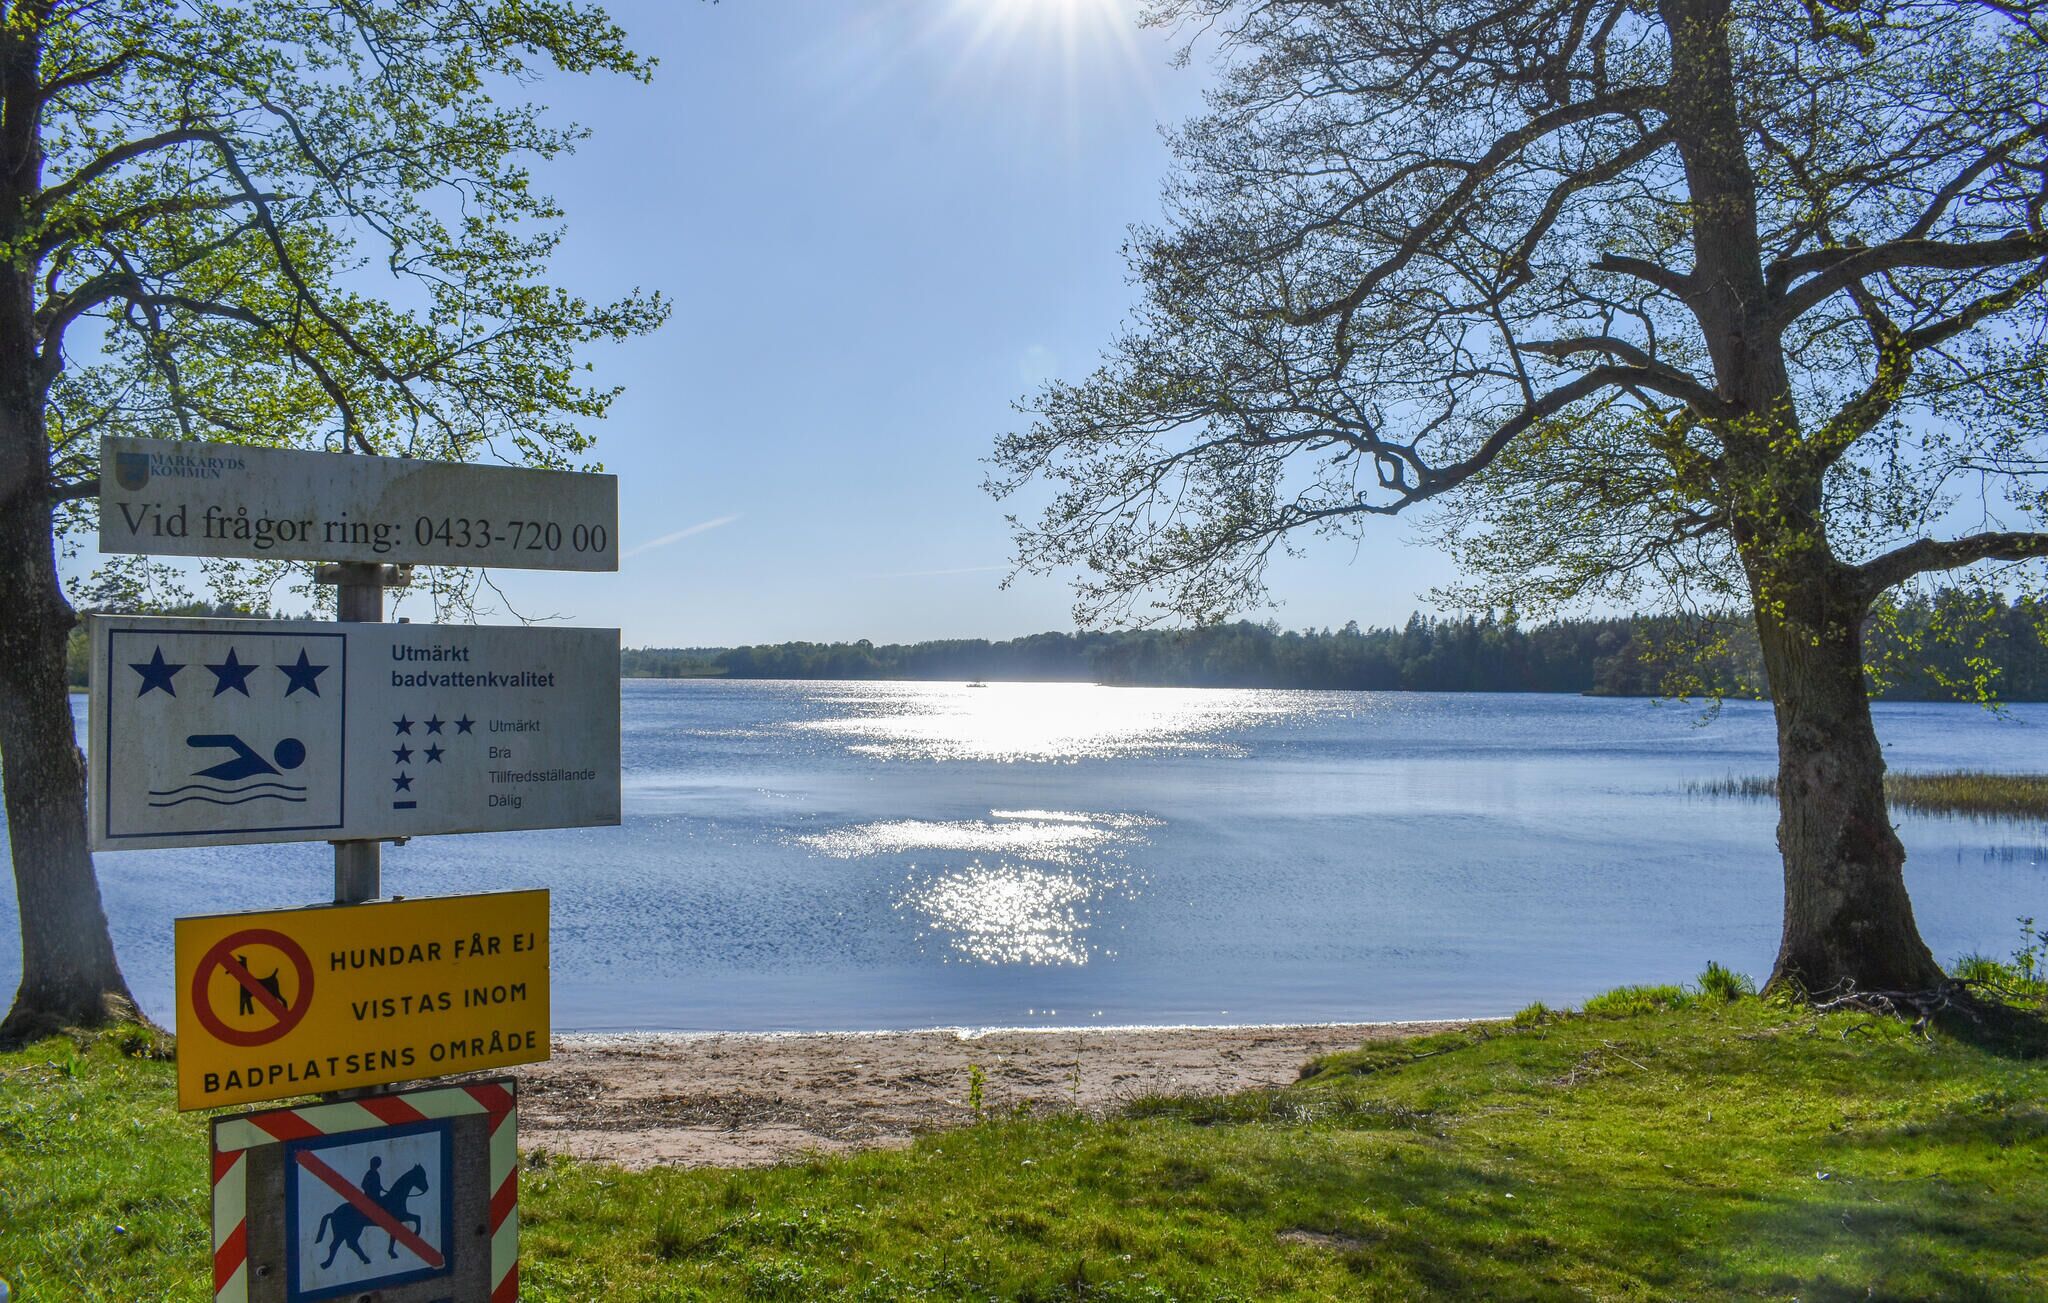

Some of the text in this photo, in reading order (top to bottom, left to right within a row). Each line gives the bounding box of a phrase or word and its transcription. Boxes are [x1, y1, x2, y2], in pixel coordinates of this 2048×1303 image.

[150, 454, 246, 470] MARKARYDS
[150, 465, 222, 479] KOMMUN
[117, 502, 608, 553] Vid frågor ring: 0433-720 00
[392, 644, 469, 662] Utmärkt
[391, 670, 555, 687] badvattenkvalitet
[489, 719, 540, 732] Utmärkt
[489, 746, 511, 759] Bra
[489, 769, 596, 783] Tillfredsställande
[488, 794, 522, 808] Dålig
[330, 933, 535, 971] HUNDAR FÅR EJ
[352, 983, 526, 1021] VISTAS INOM
[204, 1030, 537, 1093] BADPLATSENS OMRÅDE
